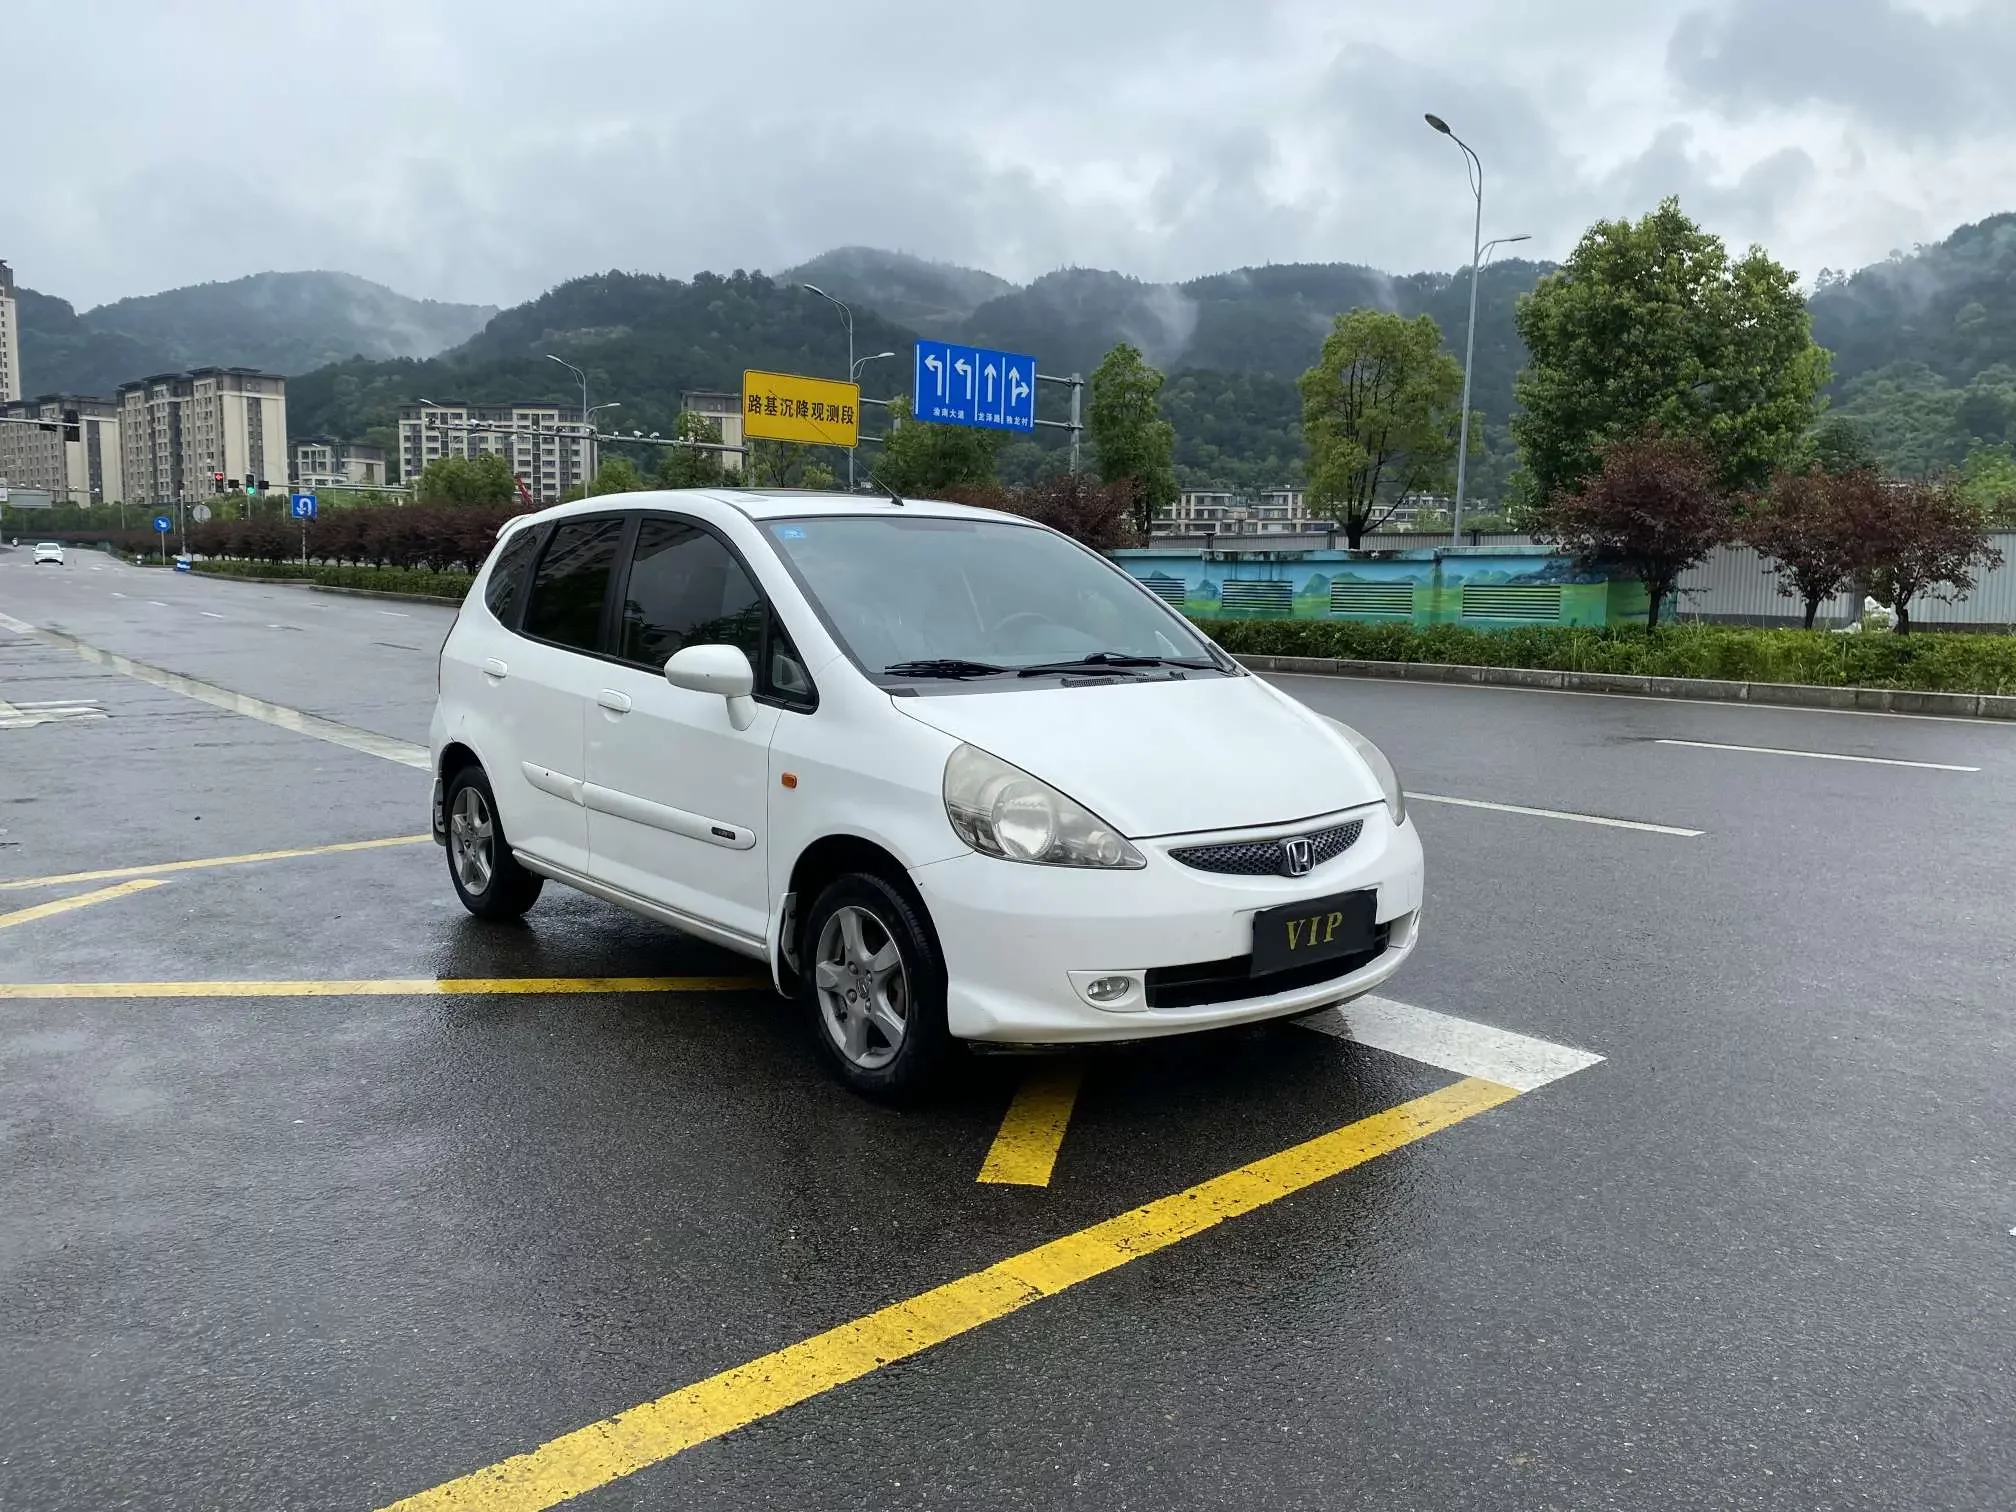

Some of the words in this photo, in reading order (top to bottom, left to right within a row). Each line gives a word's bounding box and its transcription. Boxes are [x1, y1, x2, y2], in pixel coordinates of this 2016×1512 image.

[748, 394, 855, 425] 路基沉降观测段
[1285, 911, 1344, 951] VIP
